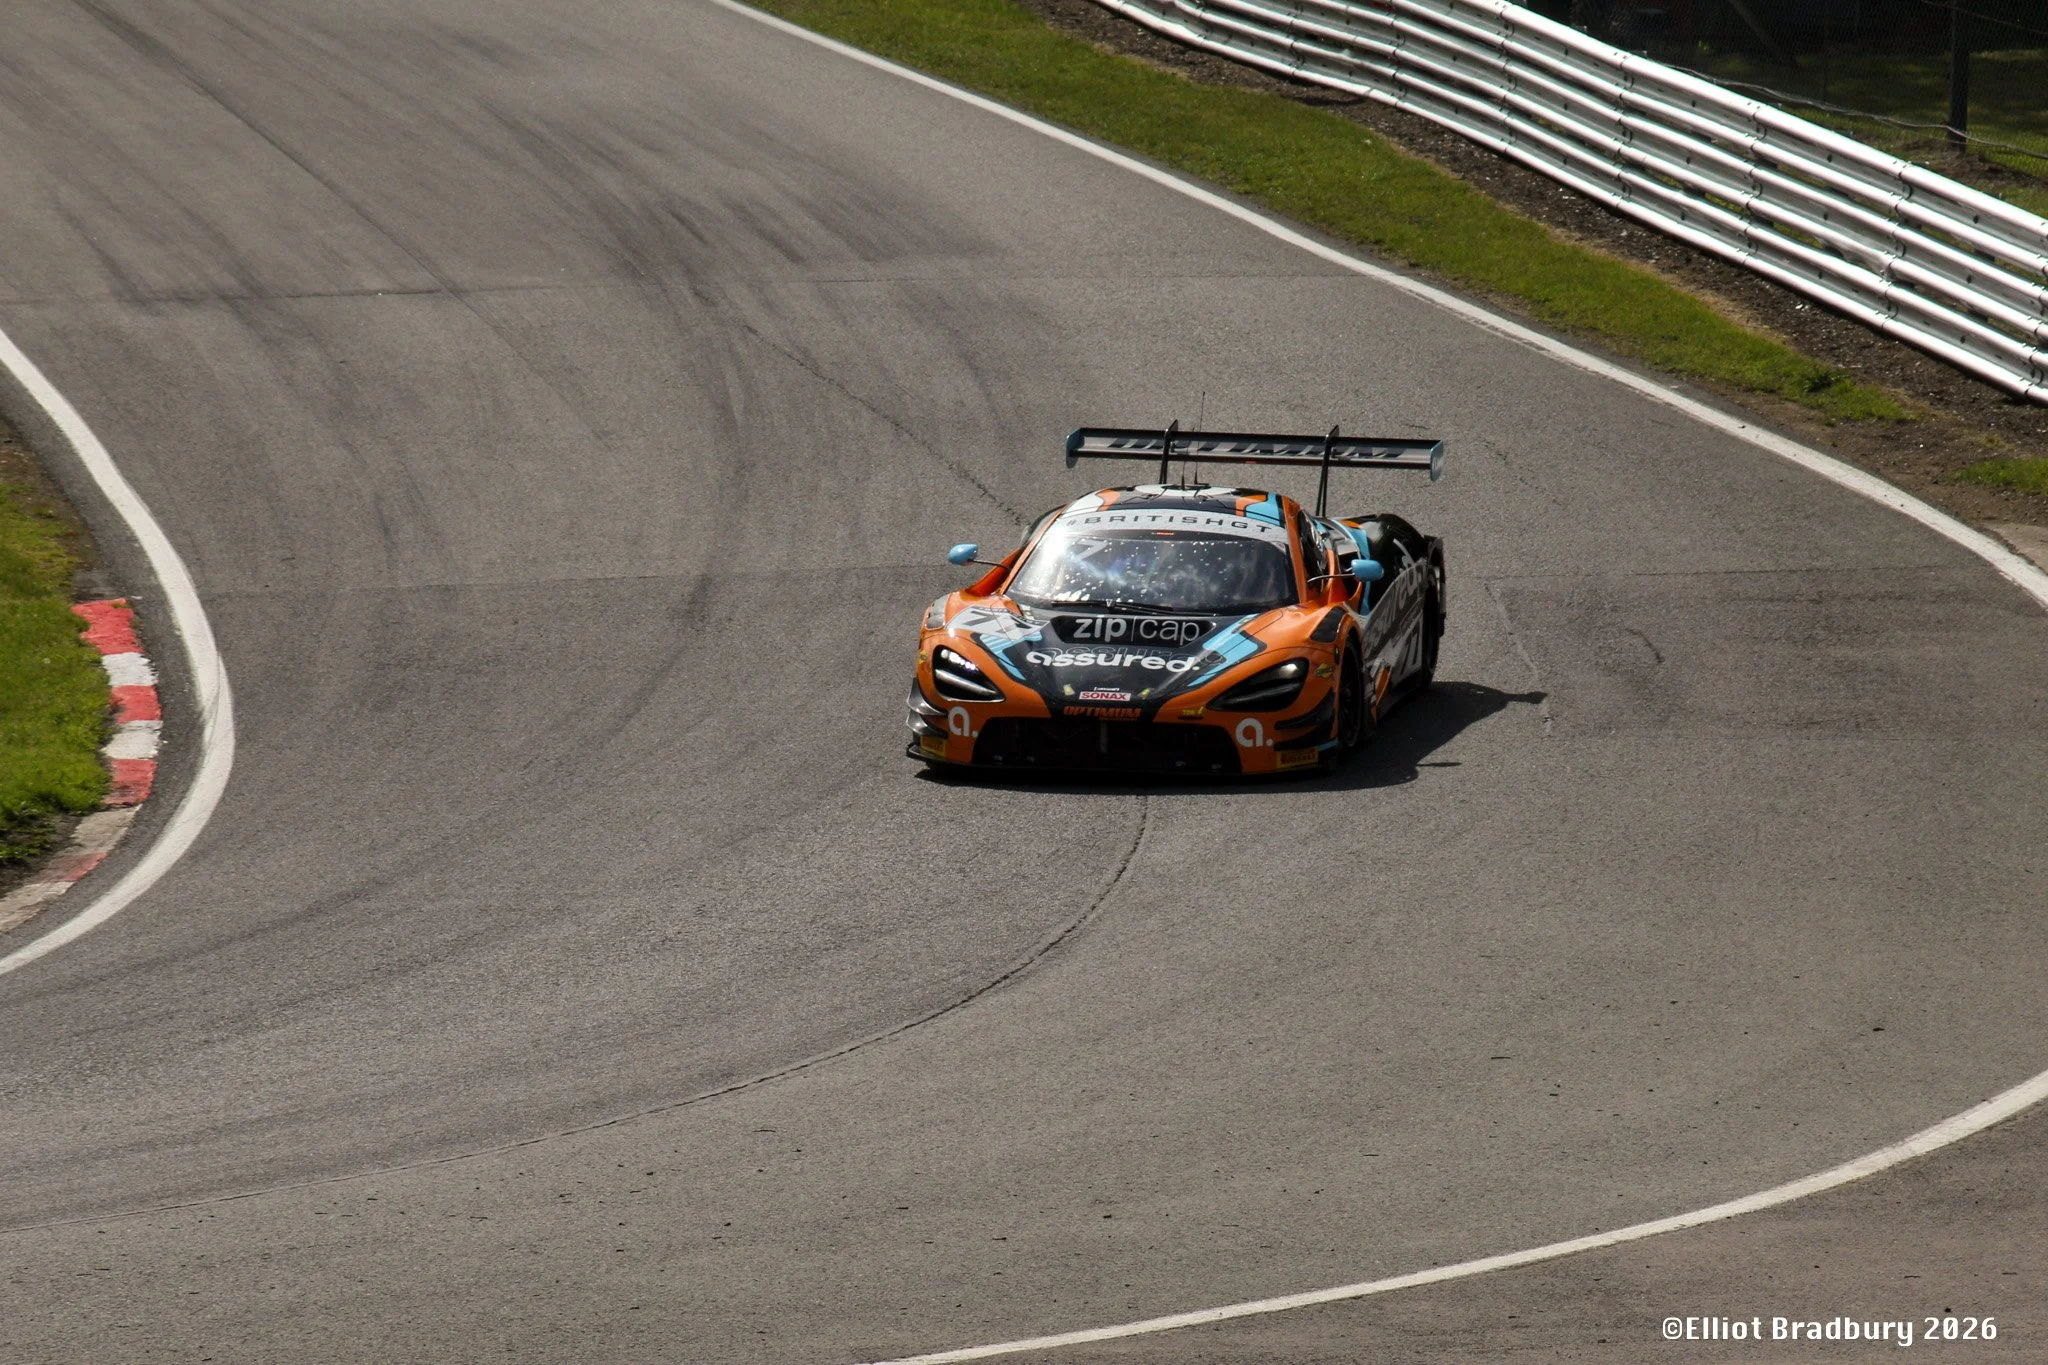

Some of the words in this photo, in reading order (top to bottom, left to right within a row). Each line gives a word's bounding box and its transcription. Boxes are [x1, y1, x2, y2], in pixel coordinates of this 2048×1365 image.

[1066, 515, 1273, 533] #BRITISHGT
[1073, 615, 1127, 643] zip
[1139, 619, 1200, 645] cap
[1025, 650, 1201, 673] assured.
[1081, 692, 1128, 700] SONAX
[947, 706, 979, 737] a.
[1063, 705, 1142, 718] OPTIMUM
[1235, 718, 1275, 748] a.
